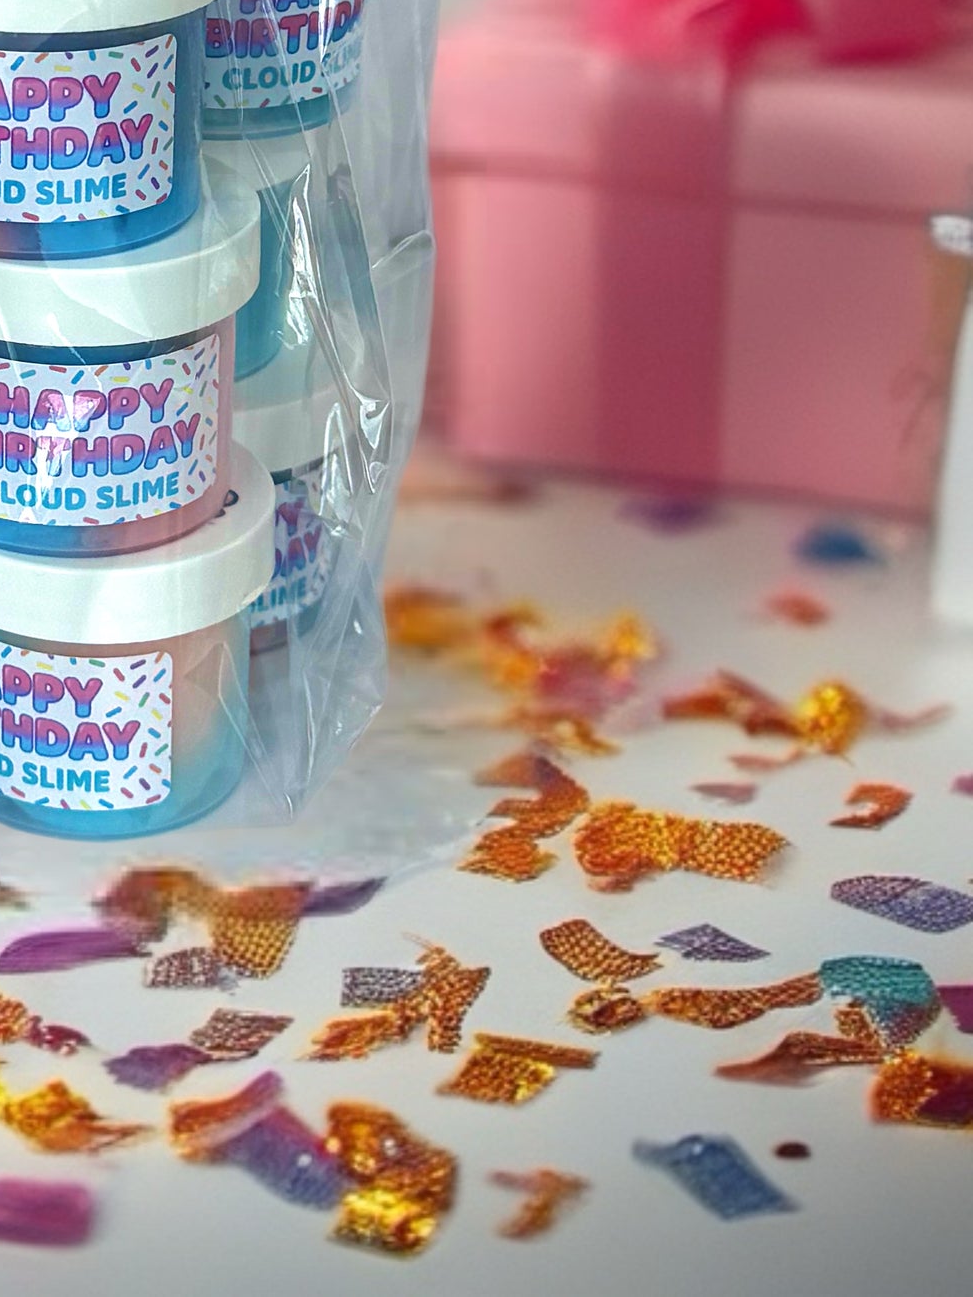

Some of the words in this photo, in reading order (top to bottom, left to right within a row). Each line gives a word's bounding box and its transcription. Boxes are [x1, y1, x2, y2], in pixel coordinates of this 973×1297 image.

[222, 60, 316, 91] CLOUD
[35, 172, 127, 205] SLIME
[96, 472, 180, 510] SLIME
[22, 762, 110, 793] SLIME
